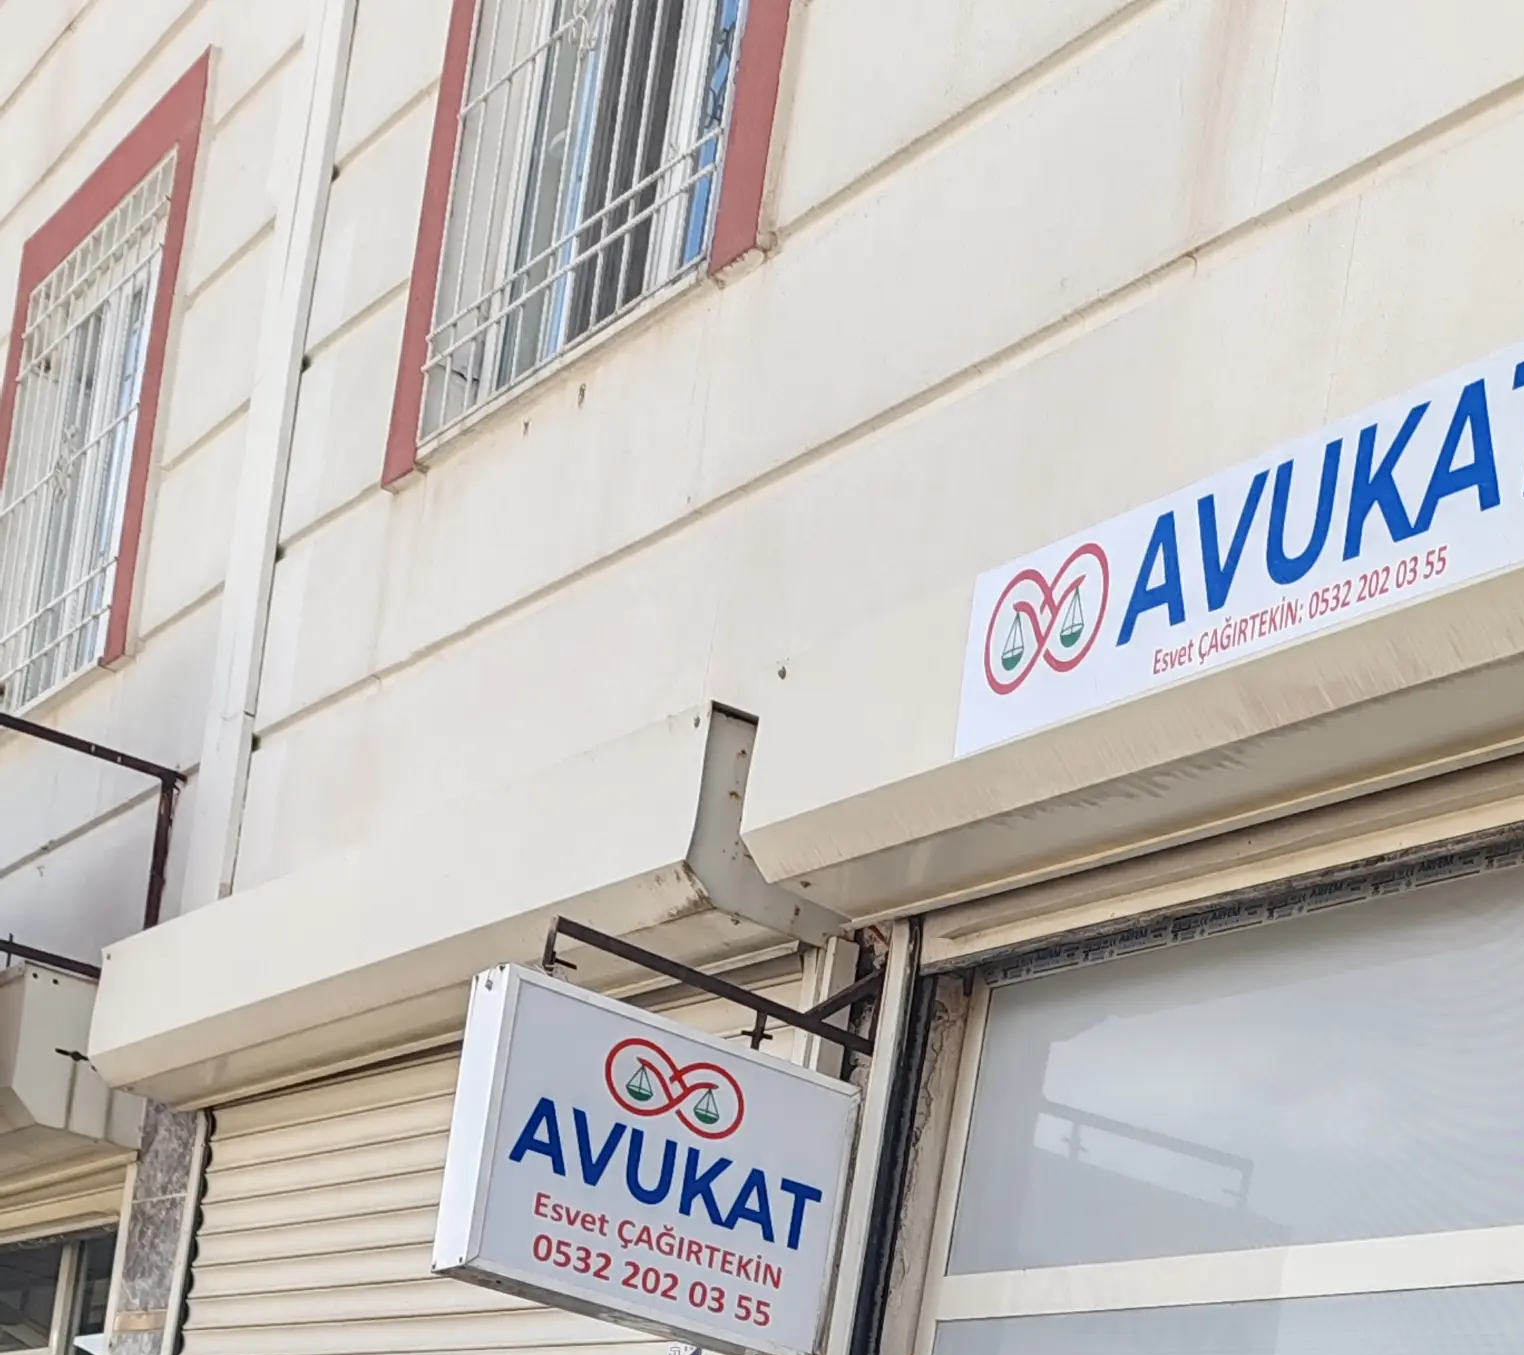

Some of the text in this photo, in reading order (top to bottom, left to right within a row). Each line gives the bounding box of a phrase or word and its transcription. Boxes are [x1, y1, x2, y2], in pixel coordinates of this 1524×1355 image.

[1153, 639, 1194, 674] Esvet
[1308, 581, 1352, 619] 0532
[1356, 567, 1392, 603] 202
[1396, 556, 1420, 588] 03
[1423, 546, 1448, 578] 55
[509, 1096, 822, 1250] AVUKAT
[533, 1233, 772, 1327] 0532 202 03 55
[534, 1191, 782, 1290] Esvet ÇAĞIRTEKİN
